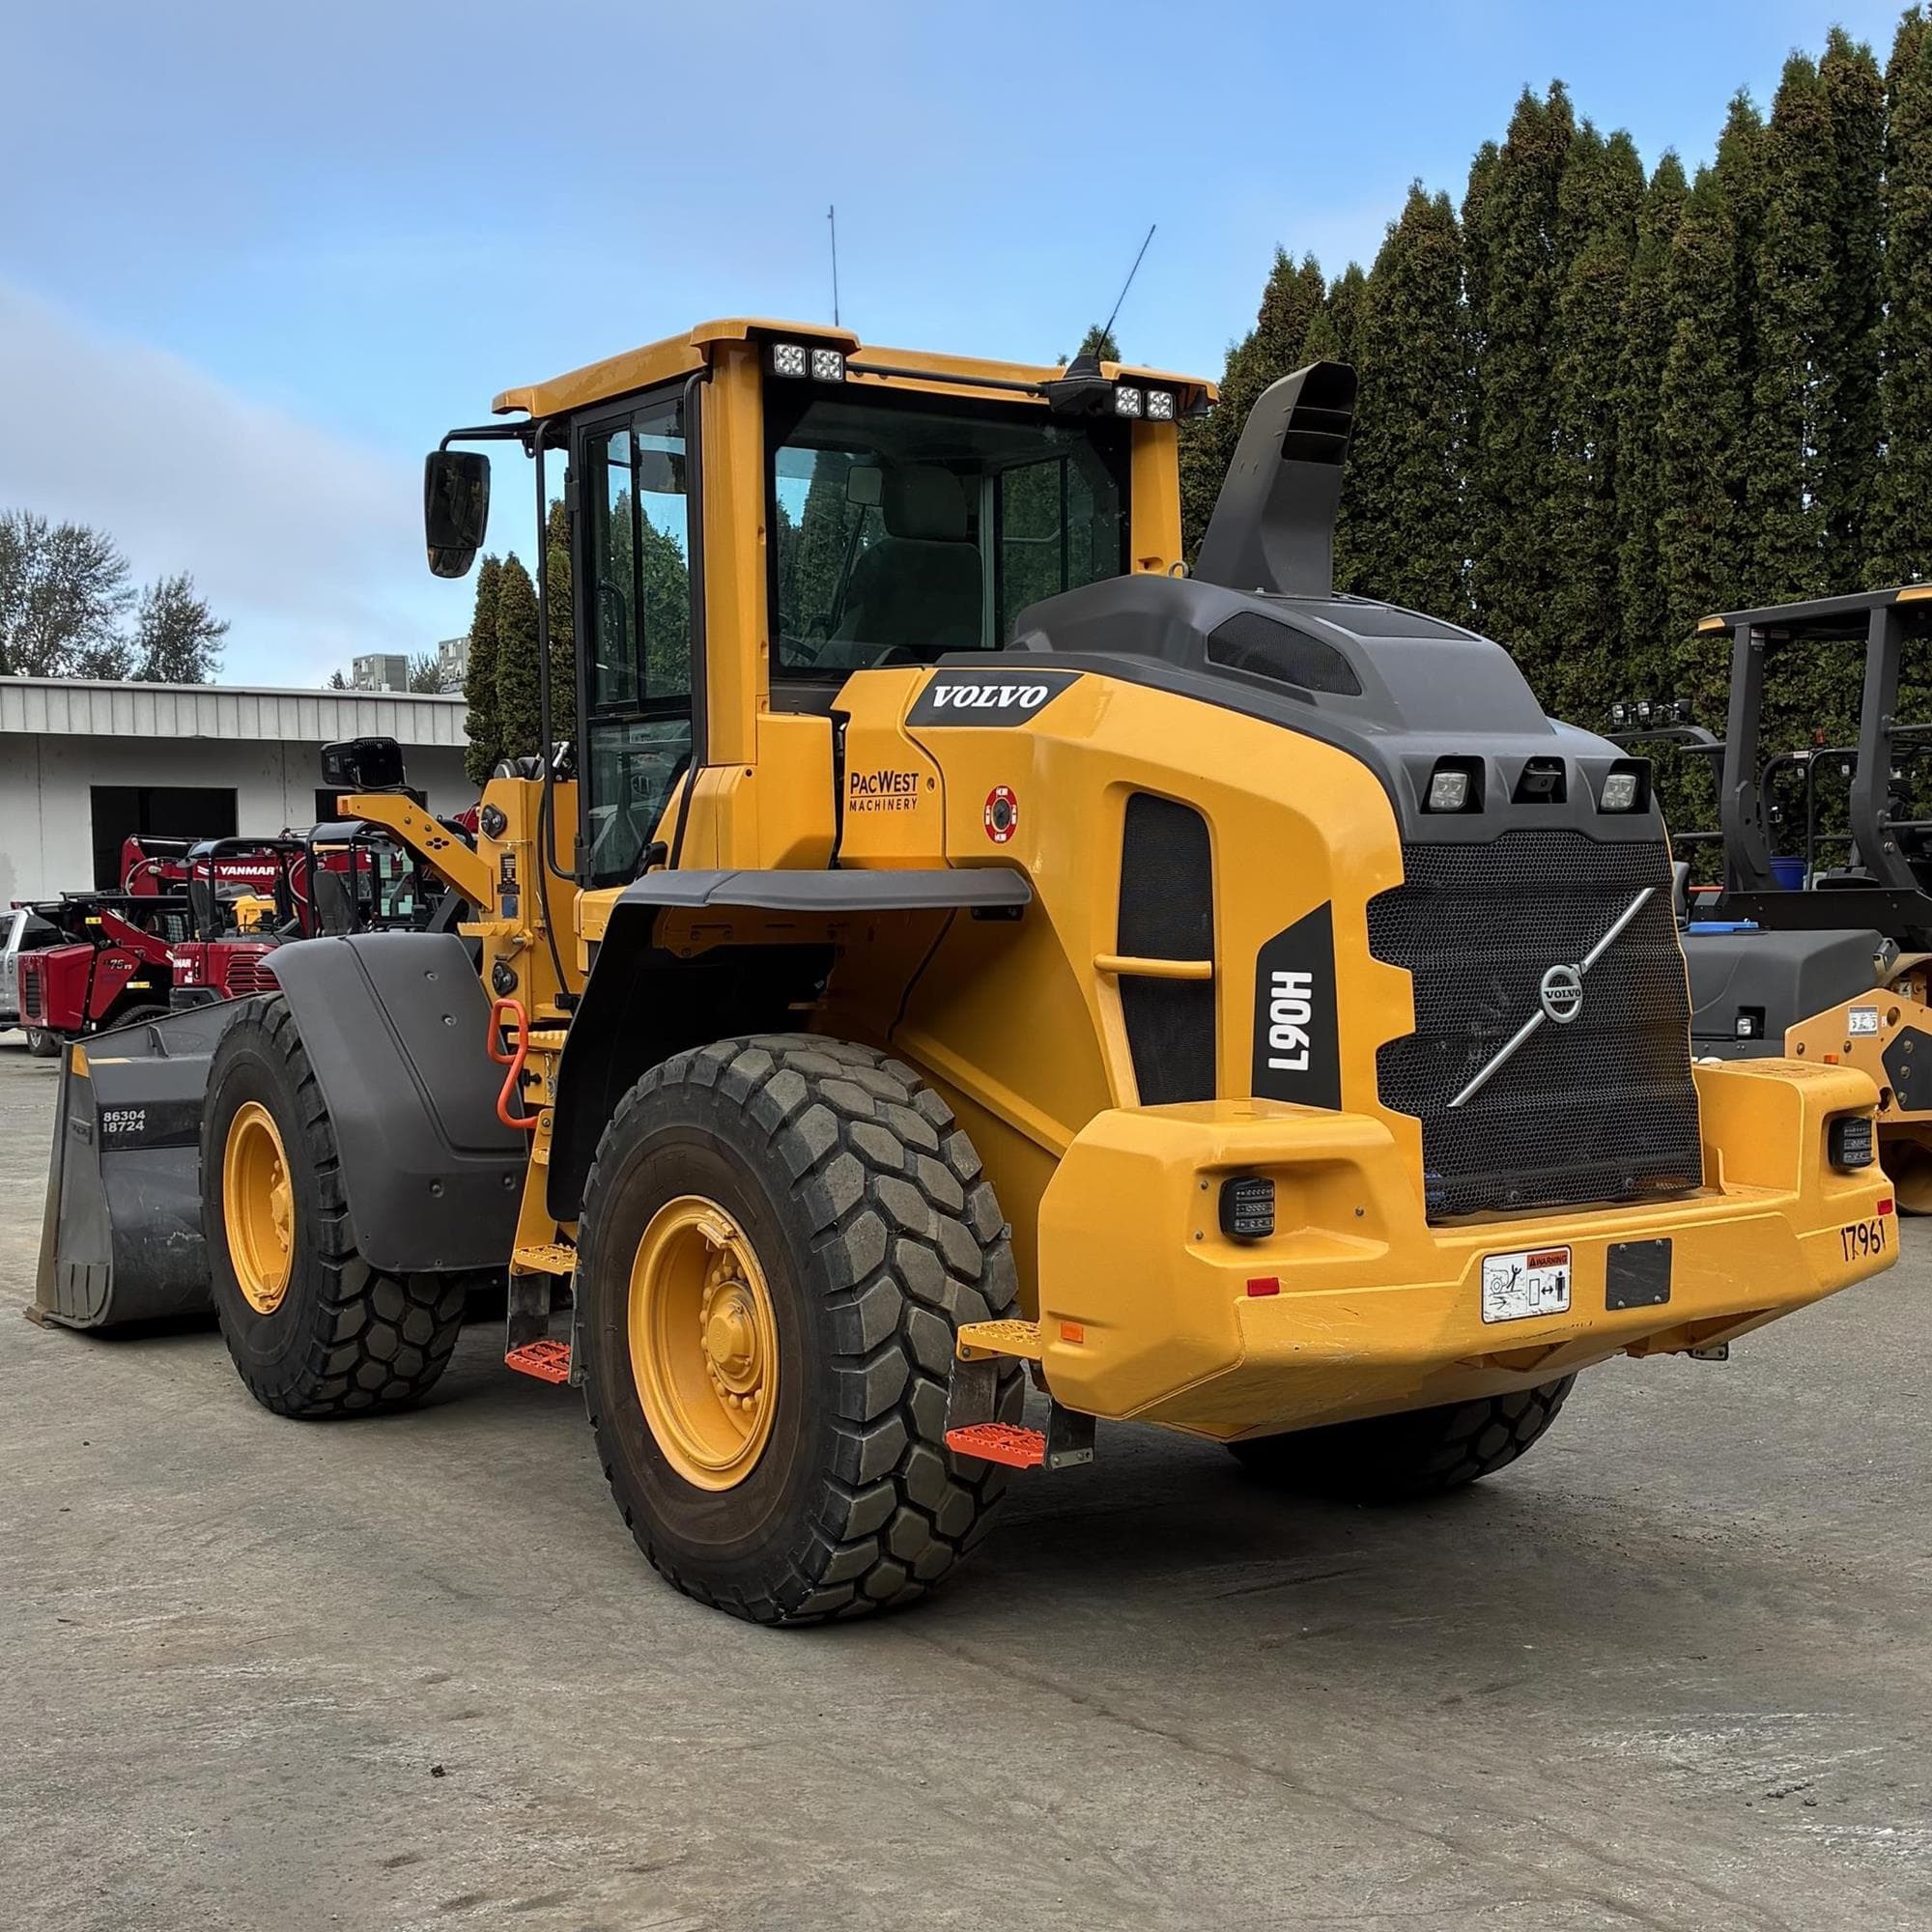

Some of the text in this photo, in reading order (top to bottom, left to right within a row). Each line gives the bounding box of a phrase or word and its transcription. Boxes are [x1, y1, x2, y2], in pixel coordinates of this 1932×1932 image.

[933, 685, 1048, 708] VOLVO
[850, 798, 917, 812] MACHINERY
[220, 866, 275, 876] YANMAR
[1544, 988, 1581, 999] VOLVO
[1268, 971, 1312, 1071] L90H
[103, 1109, 146, 1122] 86304
[1840, 1218, 1886, 1262] 17961
[1536, 1254, 1568, 1266] WARNING
